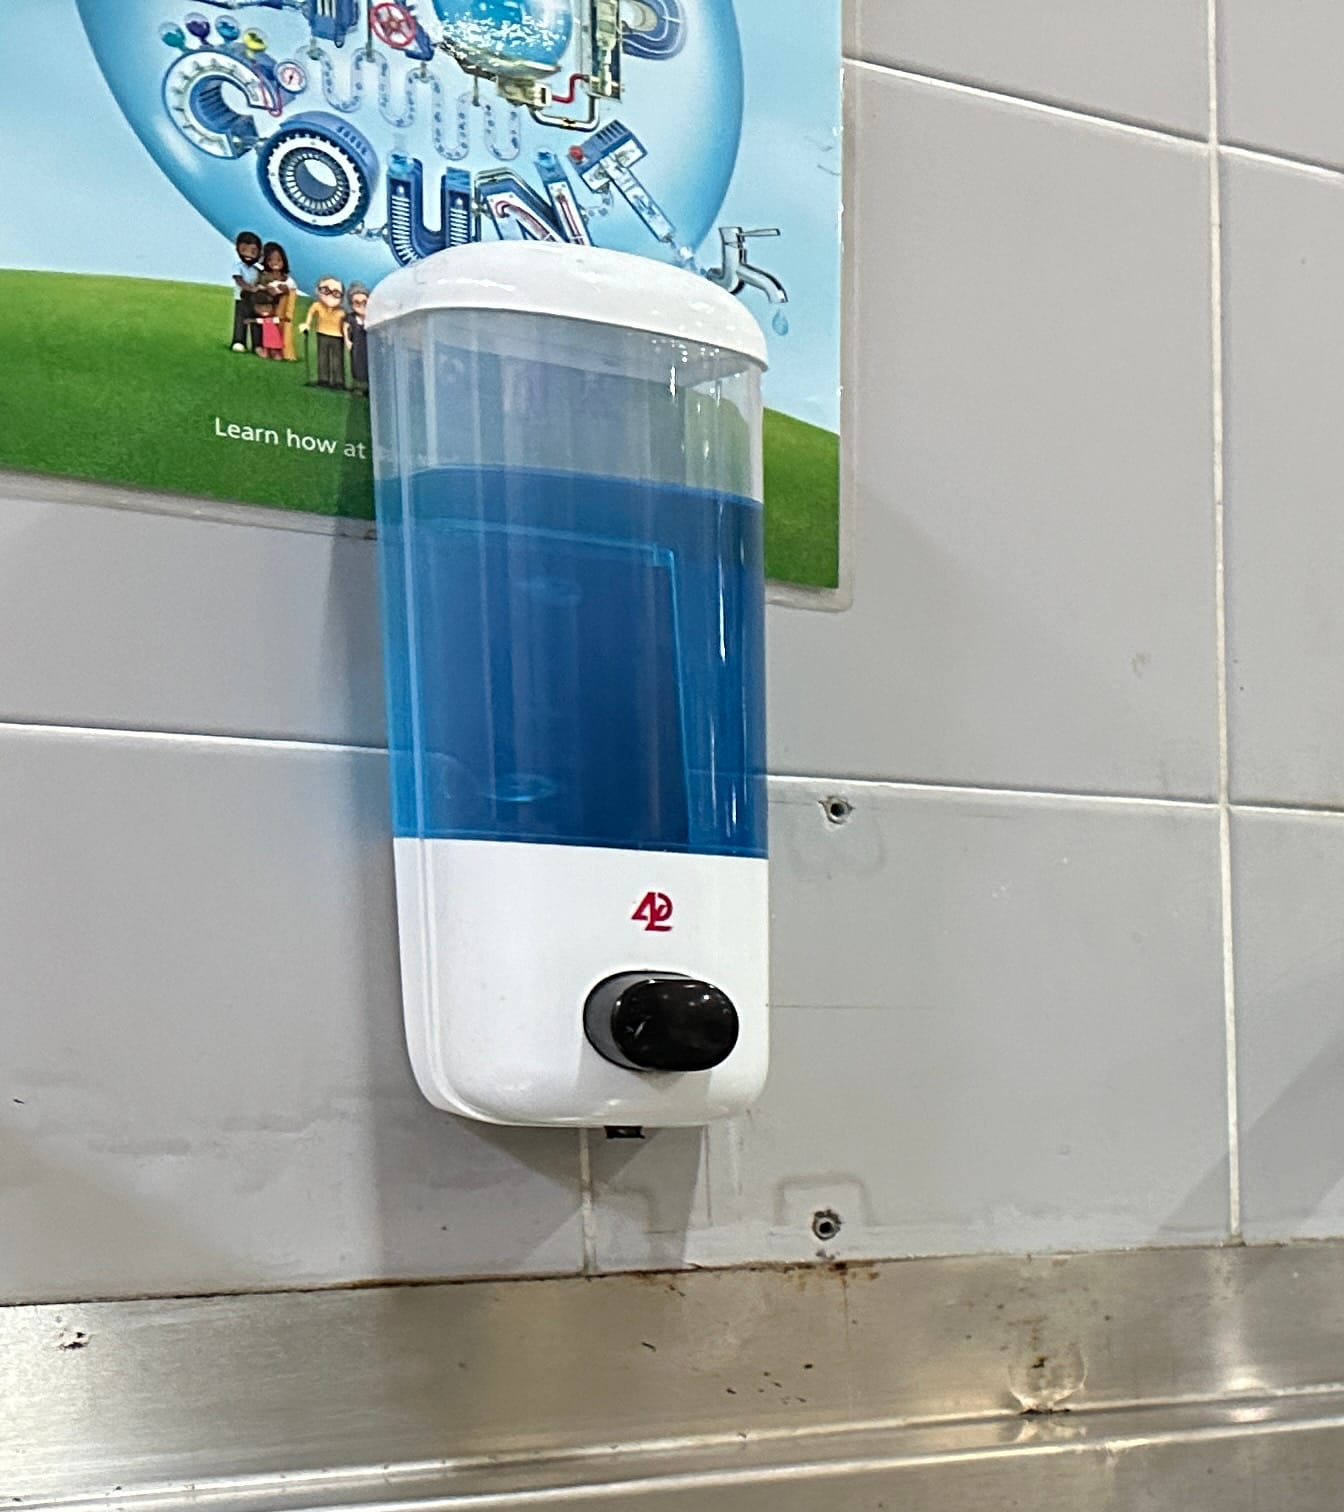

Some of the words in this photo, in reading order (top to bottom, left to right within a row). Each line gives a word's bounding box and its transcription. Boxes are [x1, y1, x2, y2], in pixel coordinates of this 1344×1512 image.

[162, 49, 680, 265] COUNT
[214, 416, 279, 445] Learn
[286, 428, 338, 454] how
[343, 440, 367, 460] at
